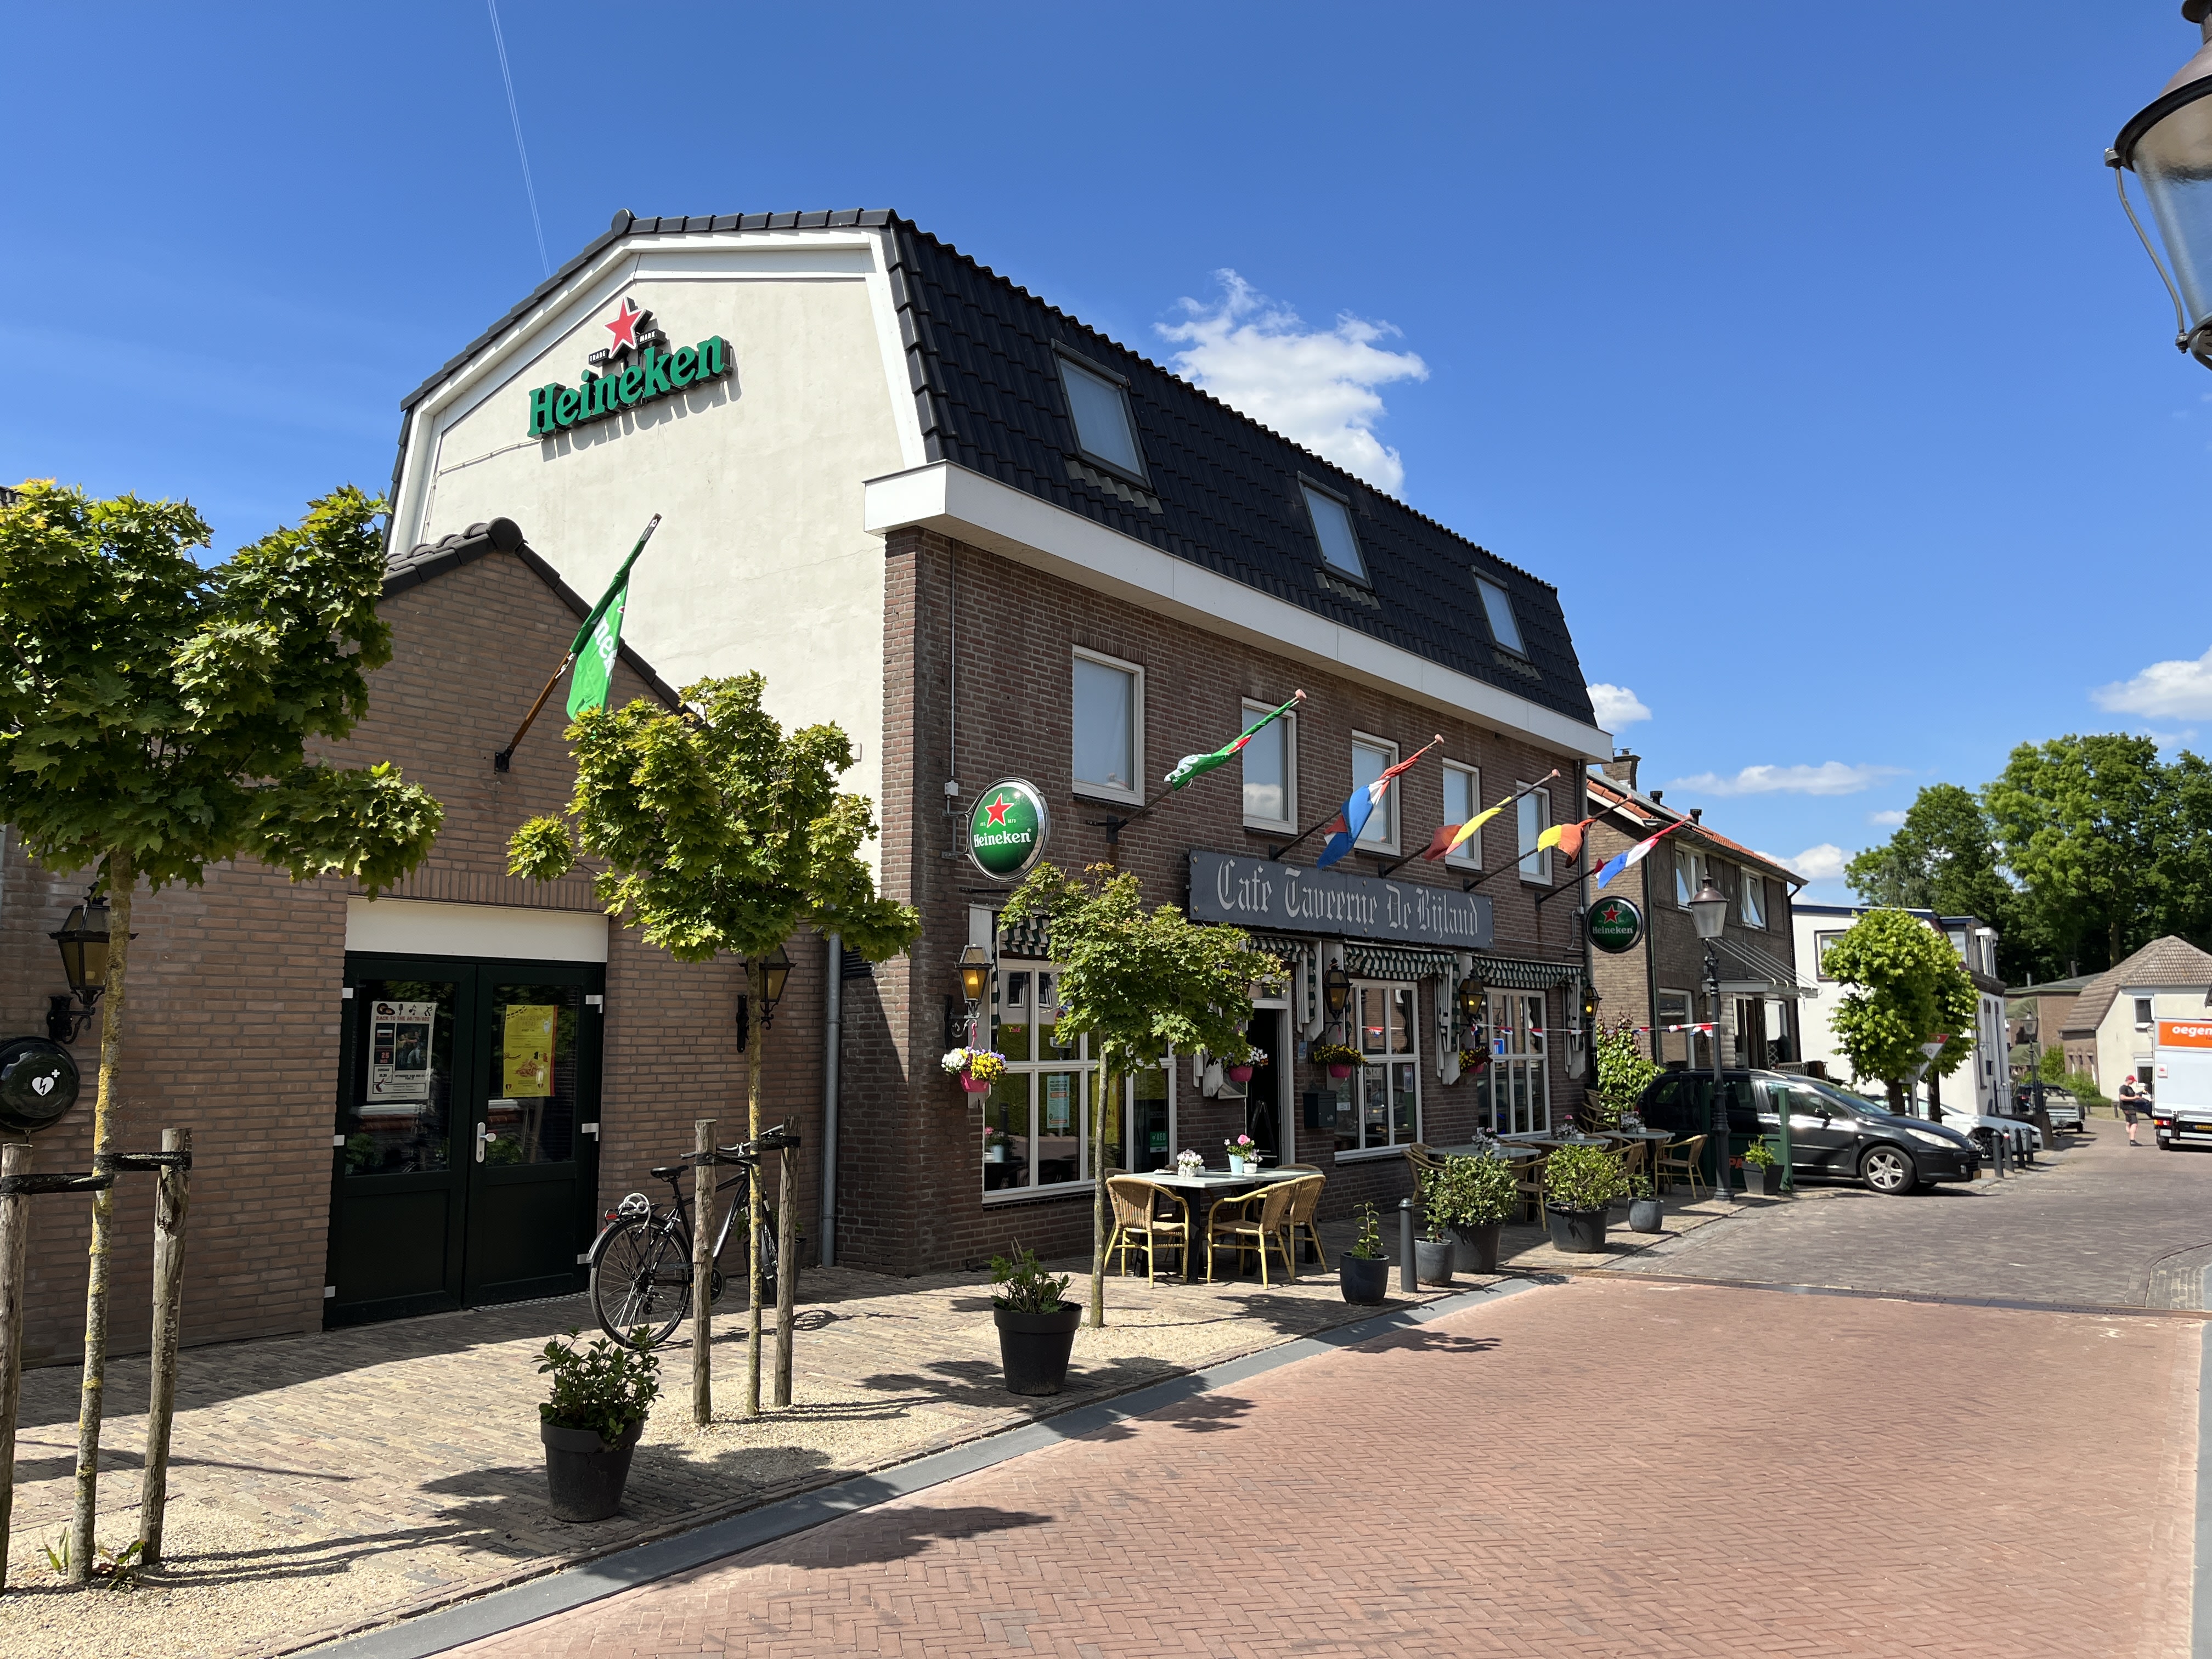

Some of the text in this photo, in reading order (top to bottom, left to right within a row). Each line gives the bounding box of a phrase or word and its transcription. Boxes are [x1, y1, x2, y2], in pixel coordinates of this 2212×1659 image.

[589, 331, 656, 362] TRADE MARK
[528, 335, 725, 437] Heineken
[973, 831, 1031, 848] Heineken
[1217, 859, 1478, 939] Cafe Taveerne De Bijland
